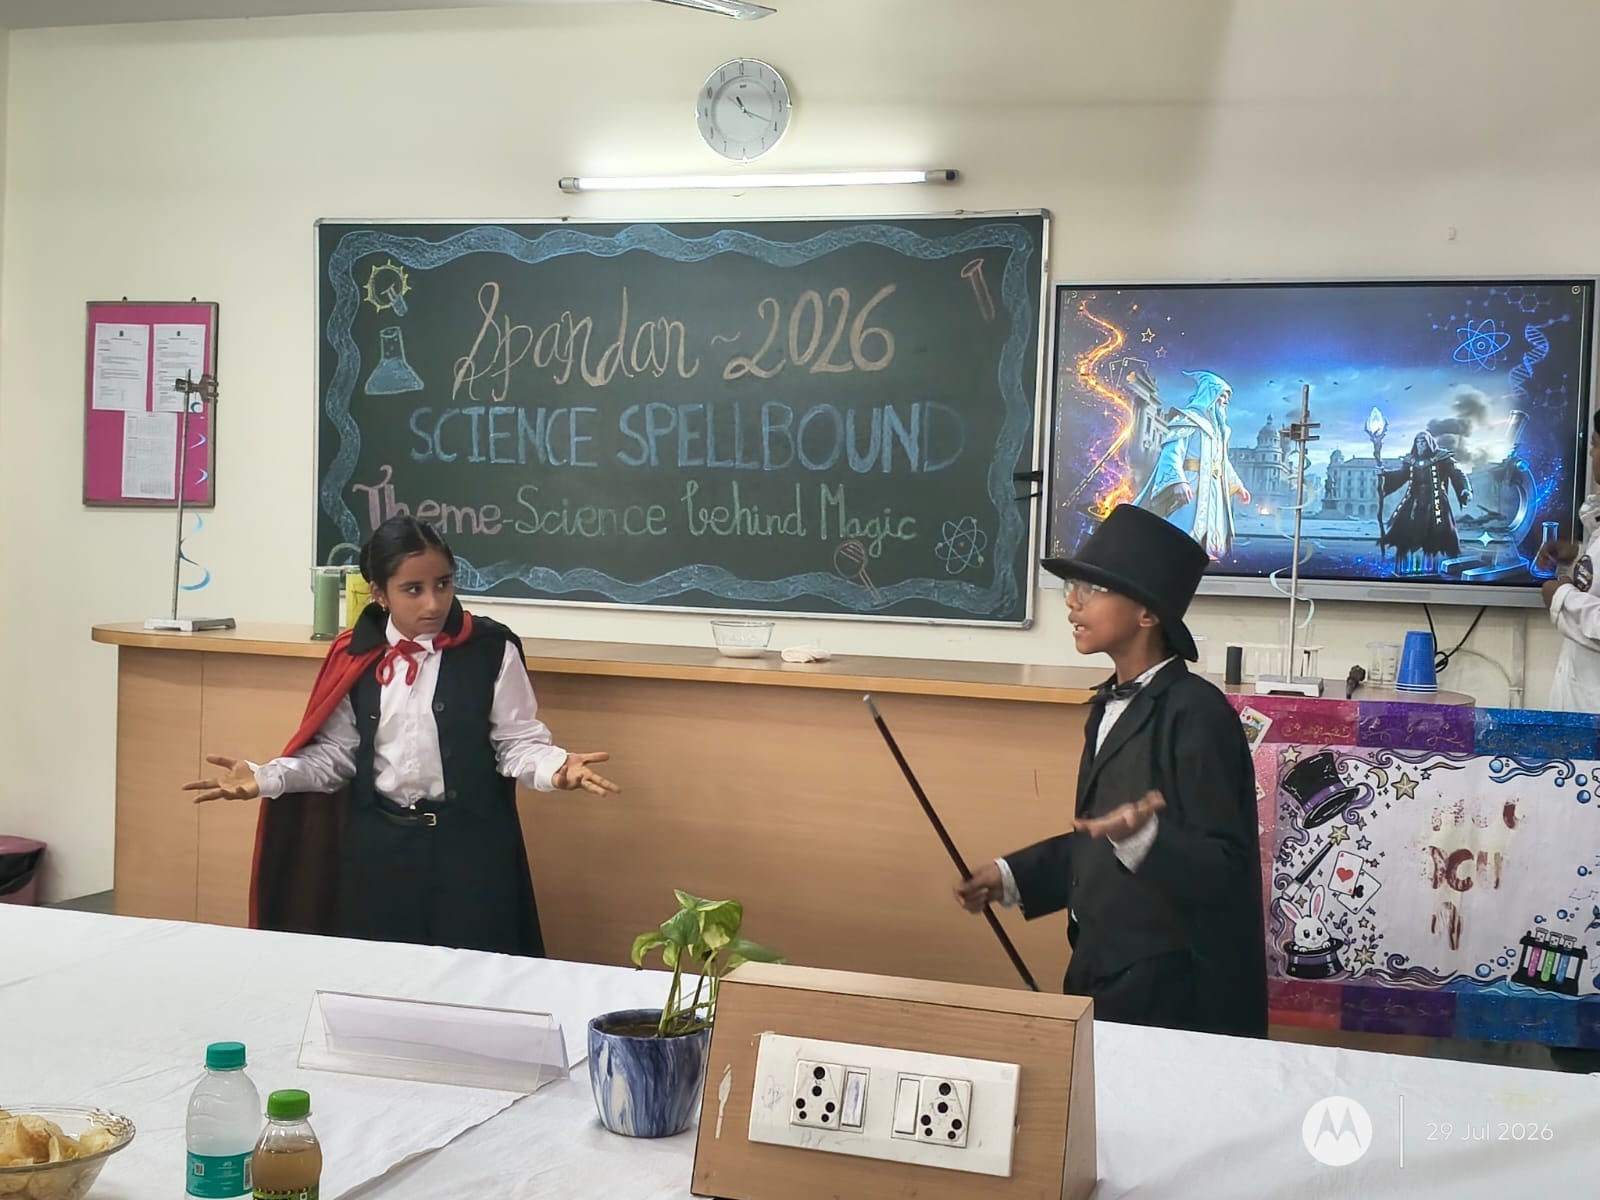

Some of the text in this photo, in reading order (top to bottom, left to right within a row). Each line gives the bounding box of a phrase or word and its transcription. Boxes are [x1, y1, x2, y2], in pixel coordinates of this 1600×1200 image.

[452, 281, 699, 401] Spandan
[409, 402, 966, 474] SCIENCE SPELLBOUND
[681, 479, 807, 536] behind
[820, 483, 918, 557] Magic
